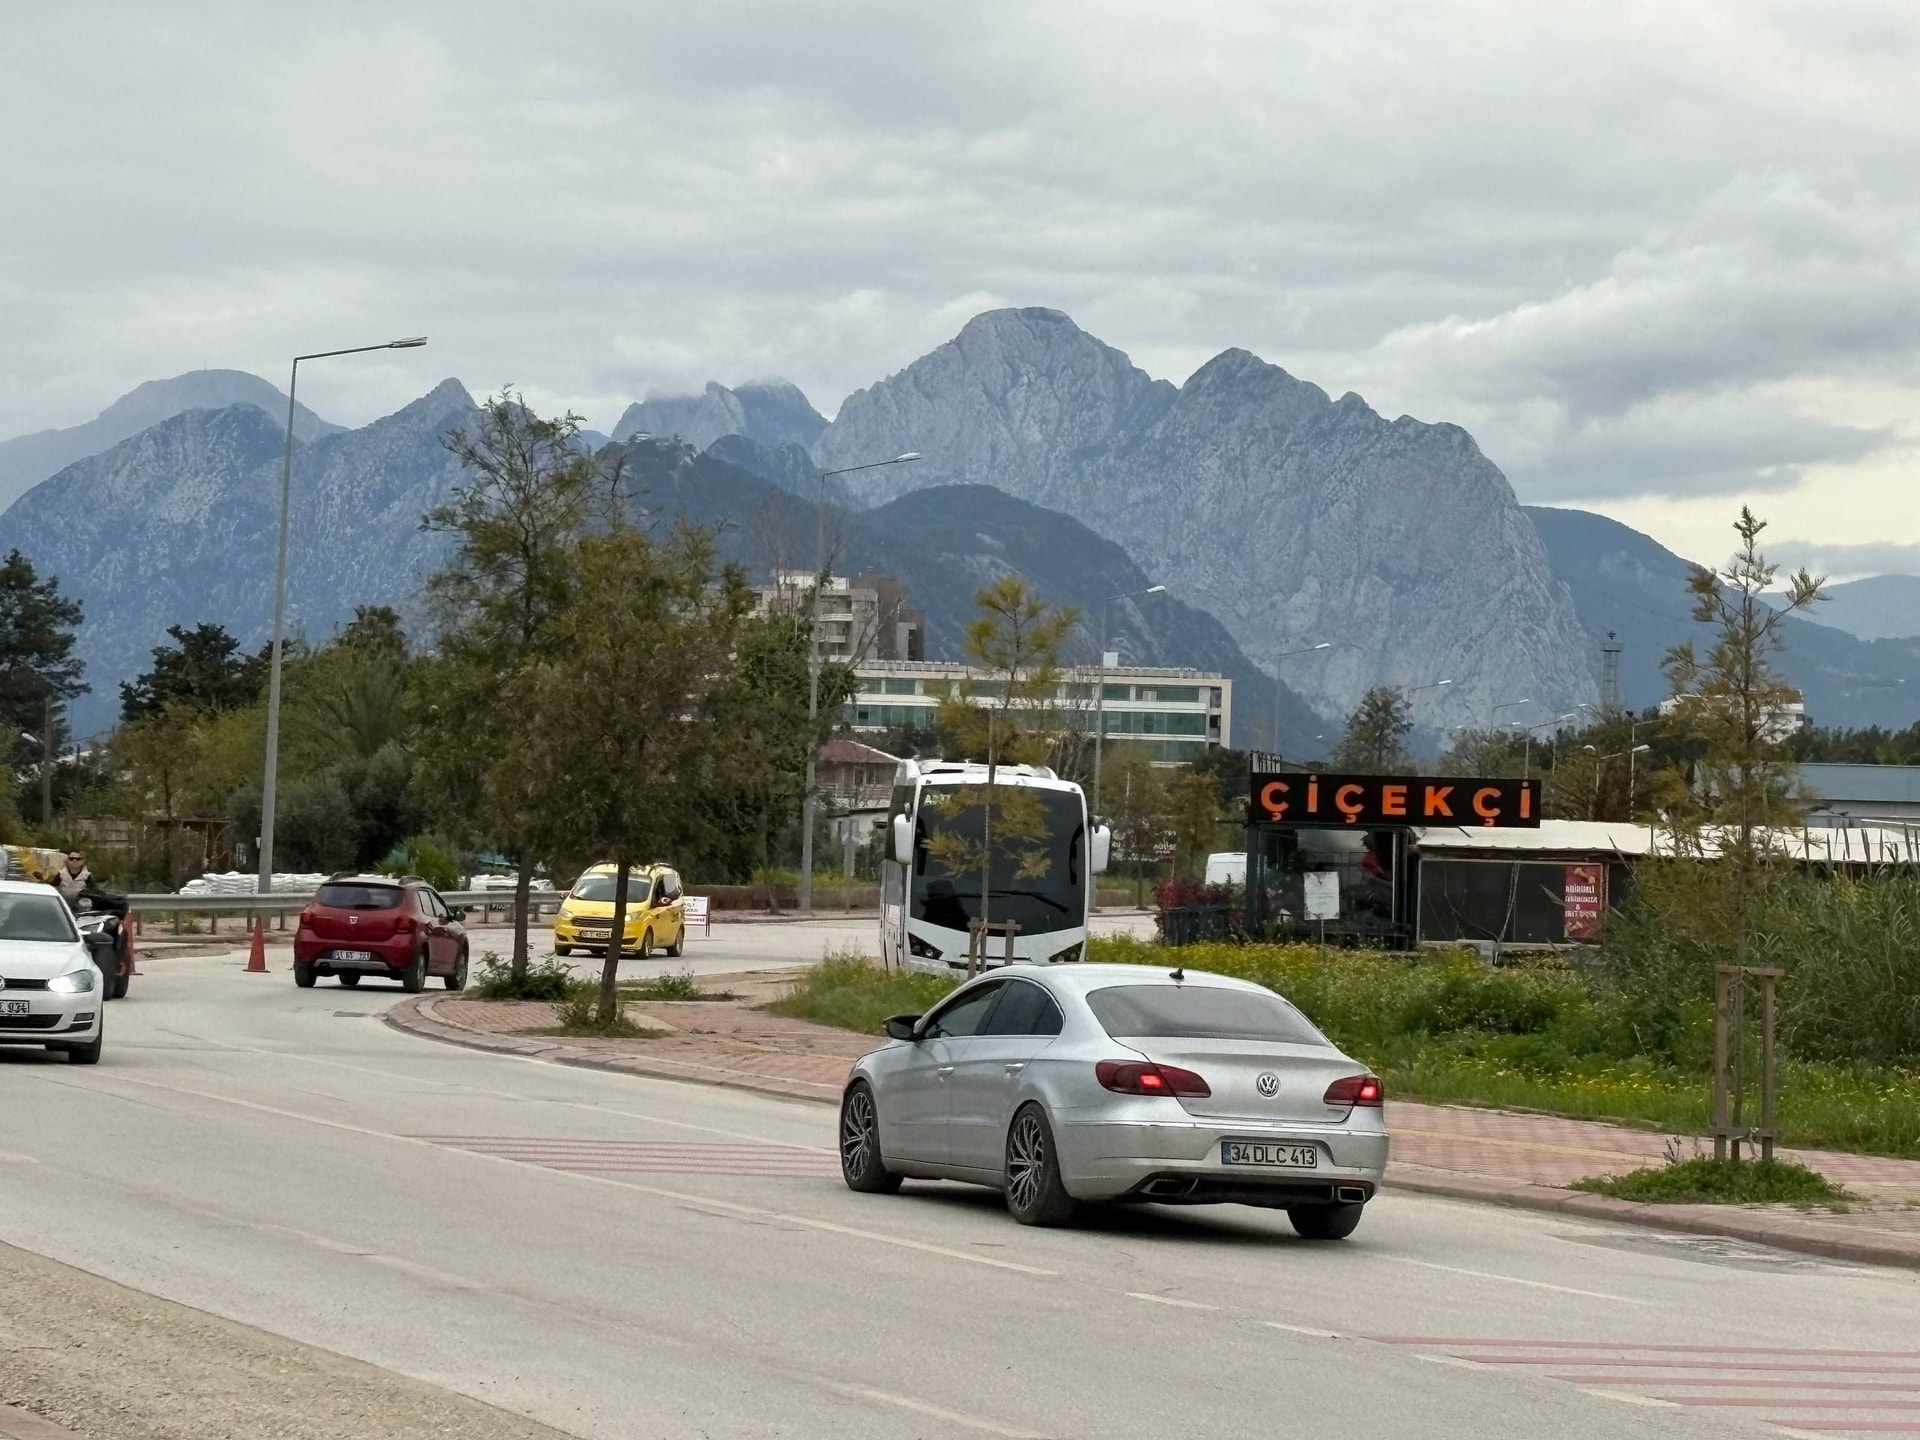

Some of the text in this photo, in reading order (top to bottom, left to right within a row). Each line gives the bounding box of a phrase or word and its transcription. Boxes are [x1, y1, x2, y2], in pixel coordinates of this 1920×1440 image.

[1260, 775, 1532, 827] ÇİÇEKÇİ
[1231, 1144, 1315, 1165] 34 DLC 413
